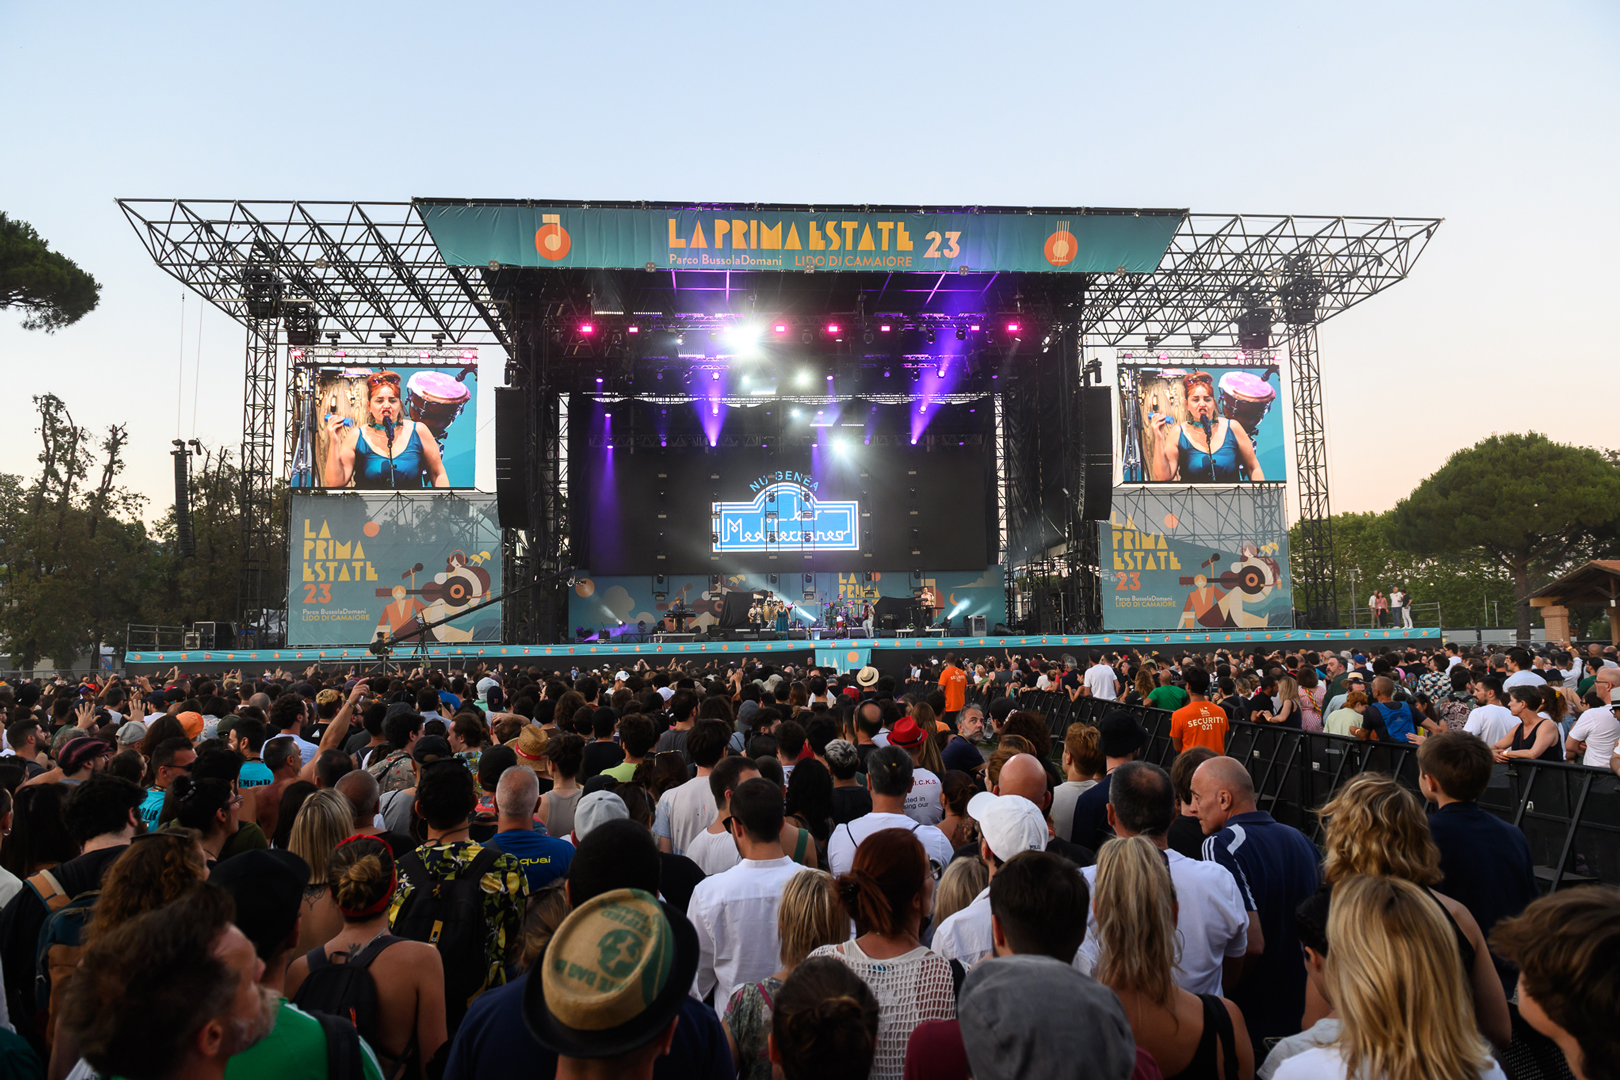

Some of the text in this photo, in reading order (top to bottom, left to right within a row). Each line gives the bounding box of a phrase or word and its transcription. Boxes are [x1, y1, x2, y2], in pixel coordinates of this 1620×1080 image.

[668, 218, 962, 259] LA PRIMA ESTATE 23
[669, 253, 699, 265] Parco
[795, 255, 913, 267] LIDO DI CAMAIORE
[749, 470, 819, 492] NU GENEA
[304, 518, 332, 539] LA
[1111, 510, 1137, 530] LA
[303, 539, 366, 560] PRIMA
[1111, 530, 1169, 550] PRIMA
[1113, 551, 1182, 570] ESTATE
[302, 561, 379, 581] ESTATE
[838, 572, 857, 584] LA
[1114, 571, 1141, 591] 23
[302, 583, 332, 604] 23
[823, 656, 839, 668] LA
[1187, 716, 1224, 728] SECURITY
[1201, 723, 1213, 731] 021
